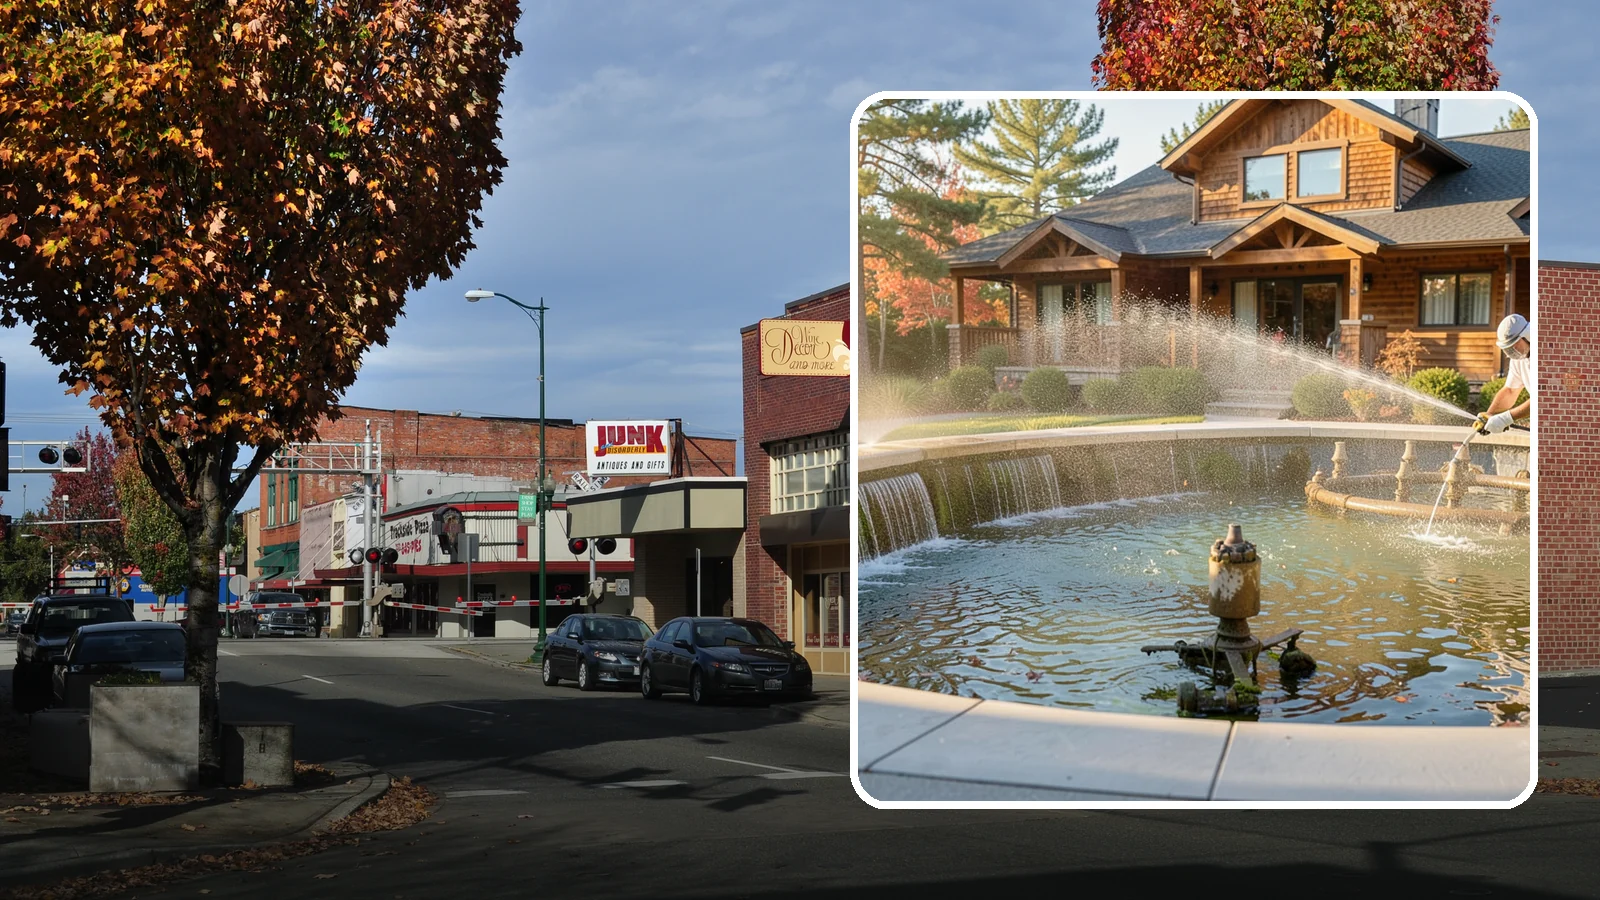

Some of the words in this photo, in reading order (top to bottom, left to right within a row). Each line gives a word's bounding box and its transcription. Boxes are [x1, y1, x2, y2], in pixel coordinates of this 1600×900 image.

[765, 327, 831, 365] Decor
[596, 425, 664, 457] JUNK
[607, 446, 646, 454] DISORDERLY
[597, 461, 628, 470] ANTIQUES
[631, 461, 644, 469] AND
[647, 460, 665, 469] GIFTS
[573, 473, 589, 491] RAIL
[390, 521, 413, 540] Trackside
[414, 519, 429, 535] Pizza
